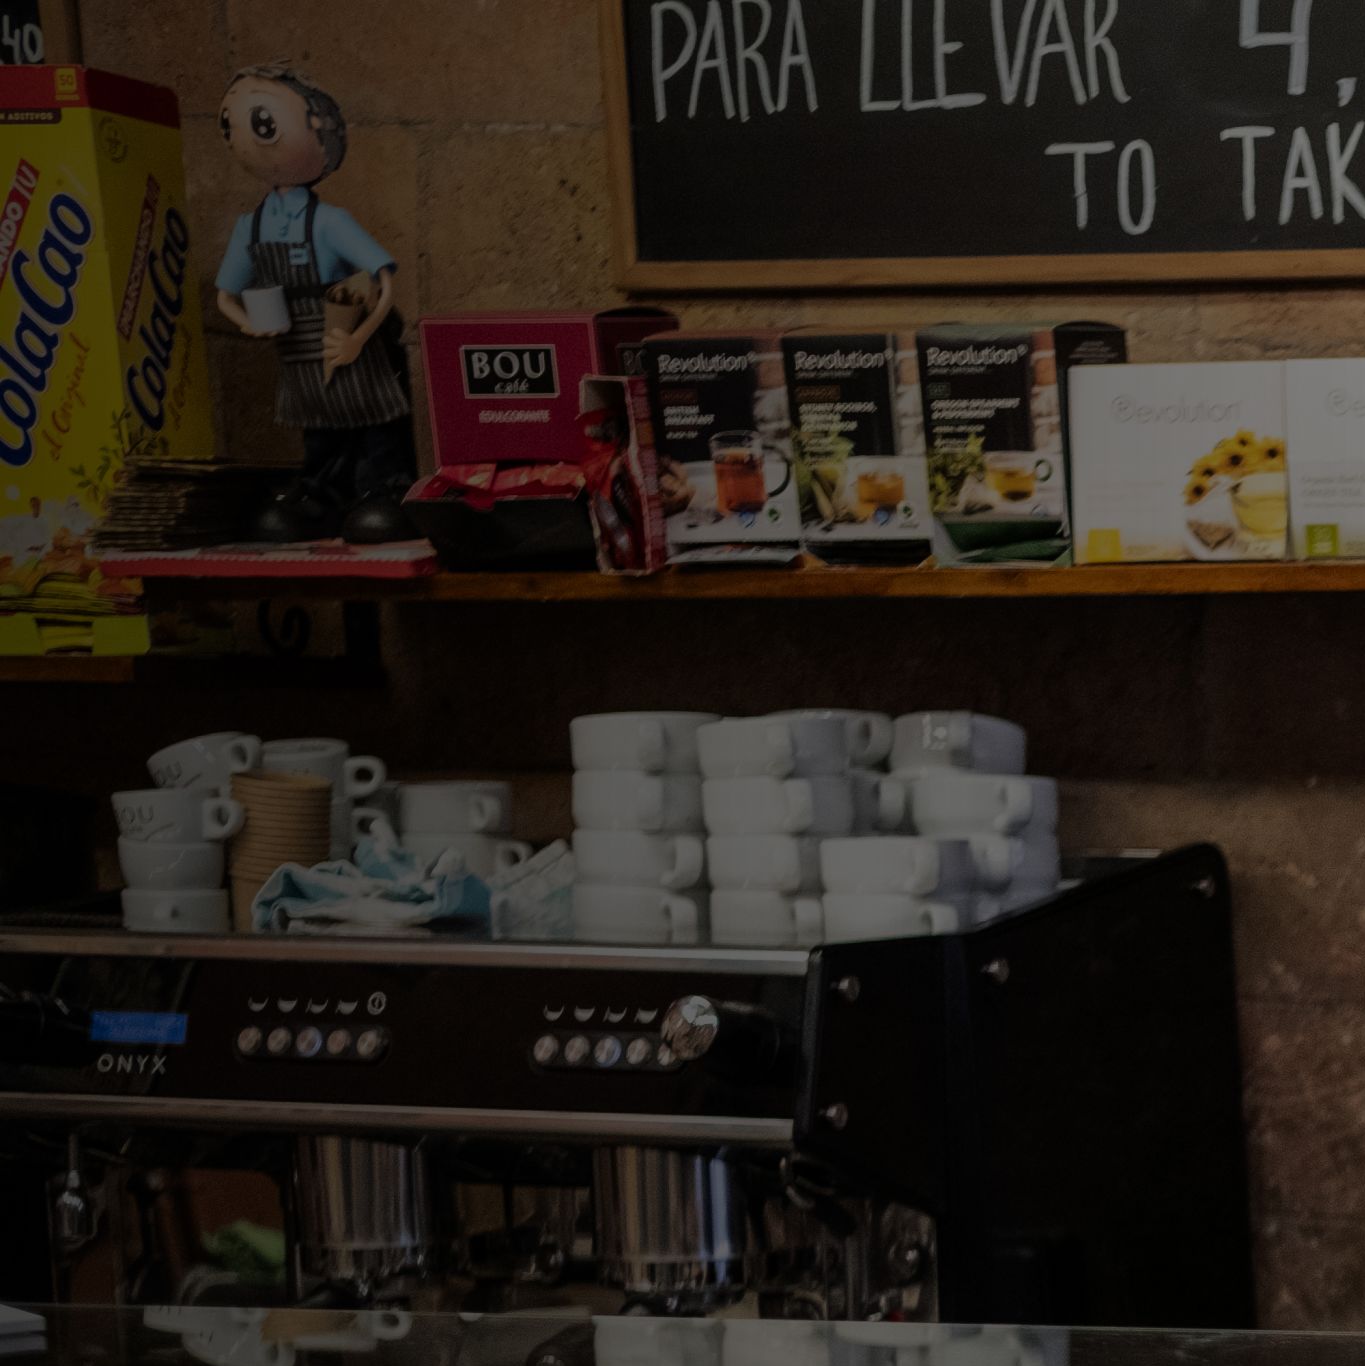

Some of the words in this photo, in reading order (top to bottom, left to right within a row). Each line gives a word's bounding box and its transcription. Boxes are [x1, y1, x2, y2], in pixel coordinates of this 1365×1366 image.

[650, 0, 817, 121] PARA
[860, 0, 1132, 111] LLEVAR
[1046, 141, 1158, 235] TO
[126, 207, 190, 432] ColaCao
[471, 350, 546, 380] BOU
[97, 1053, 167, 1075] ONYX
